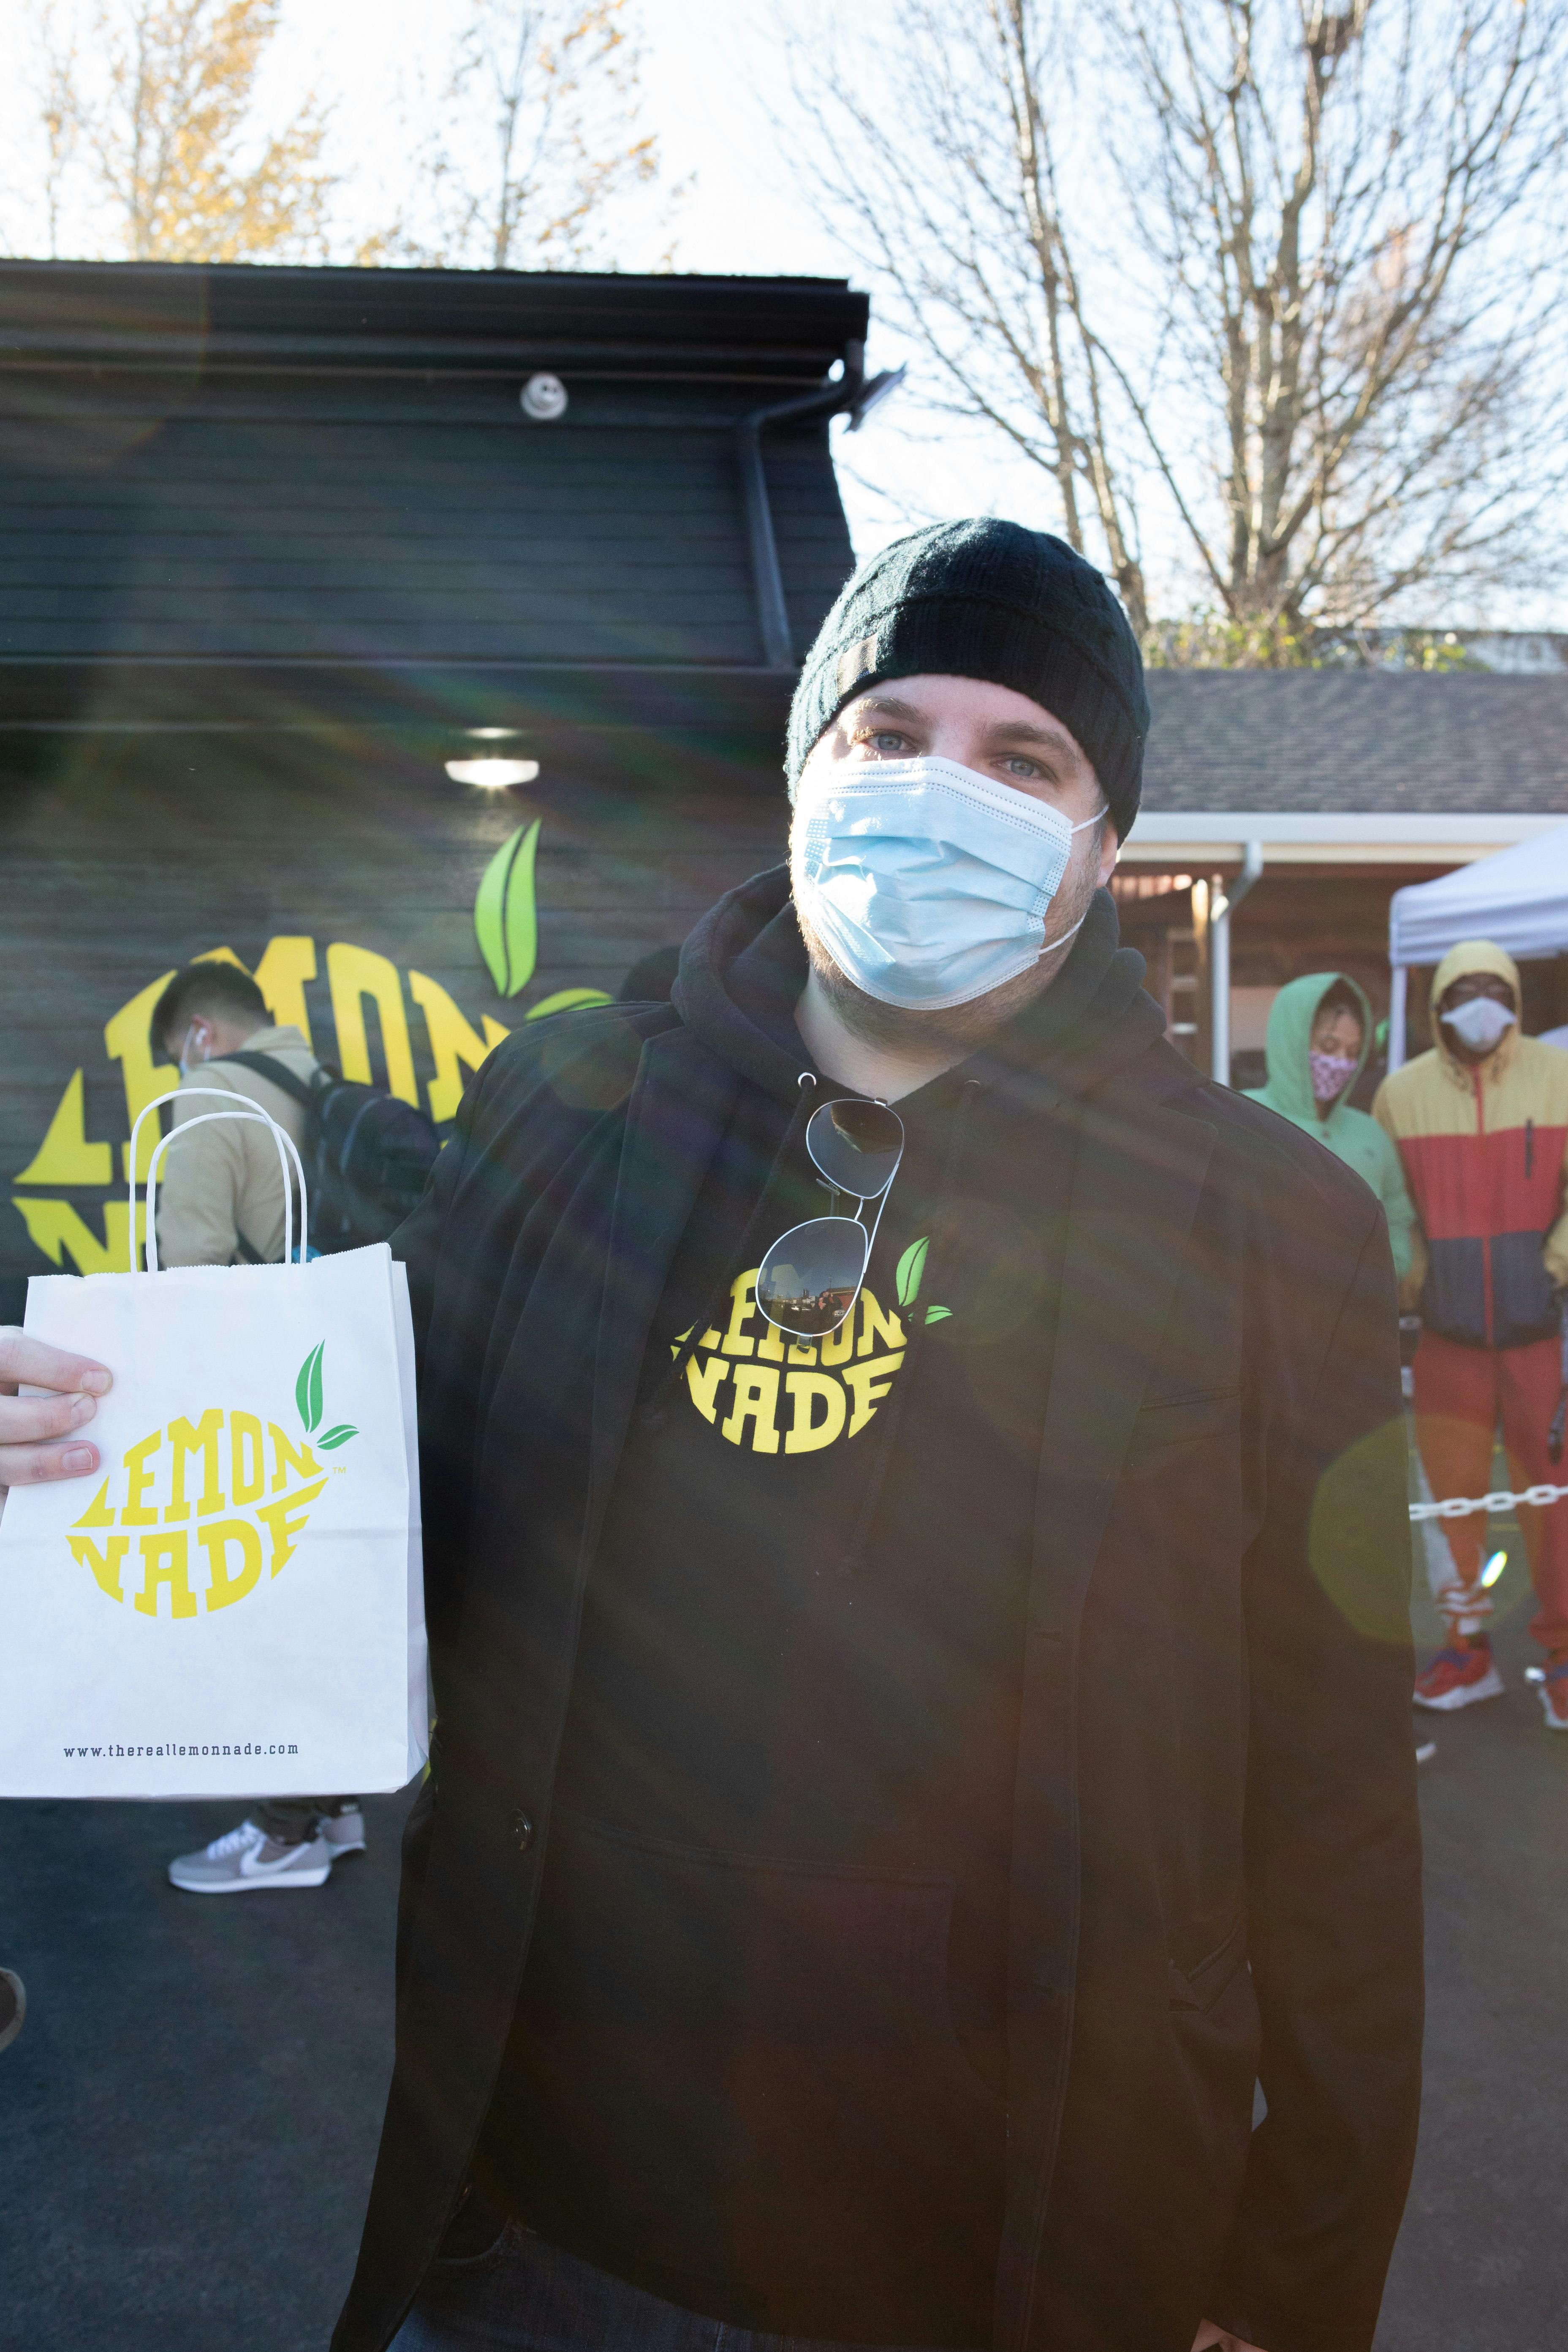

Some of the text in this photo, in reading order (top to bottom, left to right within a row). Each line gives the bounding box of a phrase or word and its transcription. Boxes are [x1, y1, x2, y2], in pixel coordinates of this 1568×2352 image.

[670, 1346, 905, 1454] NADE
[70, 1409, 323, 1527] LEMON
[65, 1477, 329, 1619] NADE
[63, 1743, 298, 1757] www.thereallemonnade.com
